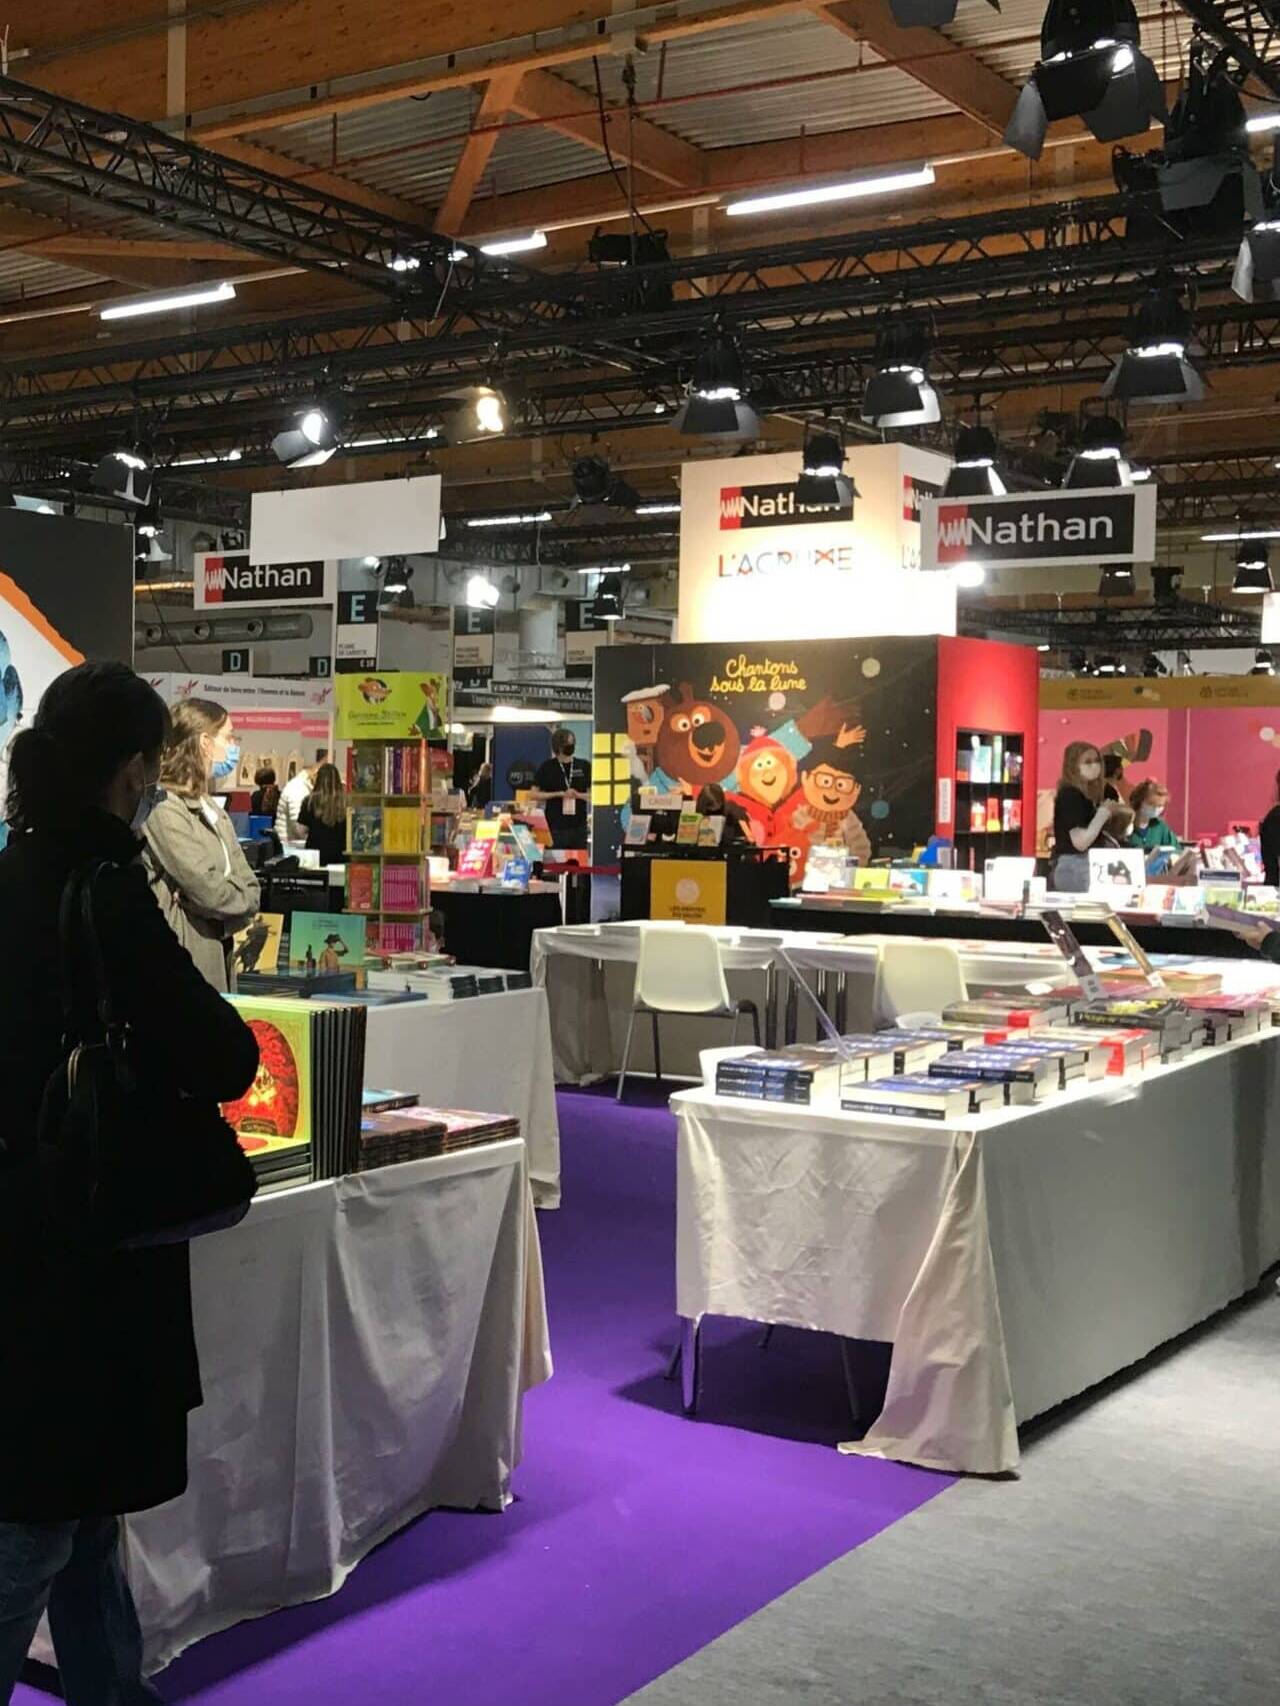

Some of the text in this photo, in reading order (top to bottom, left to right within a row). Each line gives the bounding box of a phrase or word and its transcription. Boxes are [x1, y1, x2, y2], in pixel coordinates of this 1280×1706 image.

[965, 512, 1113, 545] Nathan
[221, 563, 312, 590] Nathan
[351, 594, 366, 622] E
[468, 608, 481, 633] E
[579, 602, 595, 629] E
[230, 651, 241, 672] D
[317, 658, 328, 677] D
[725, 654, 798, 678] Chantons
[710, 675, 808, 693] sous la lune
